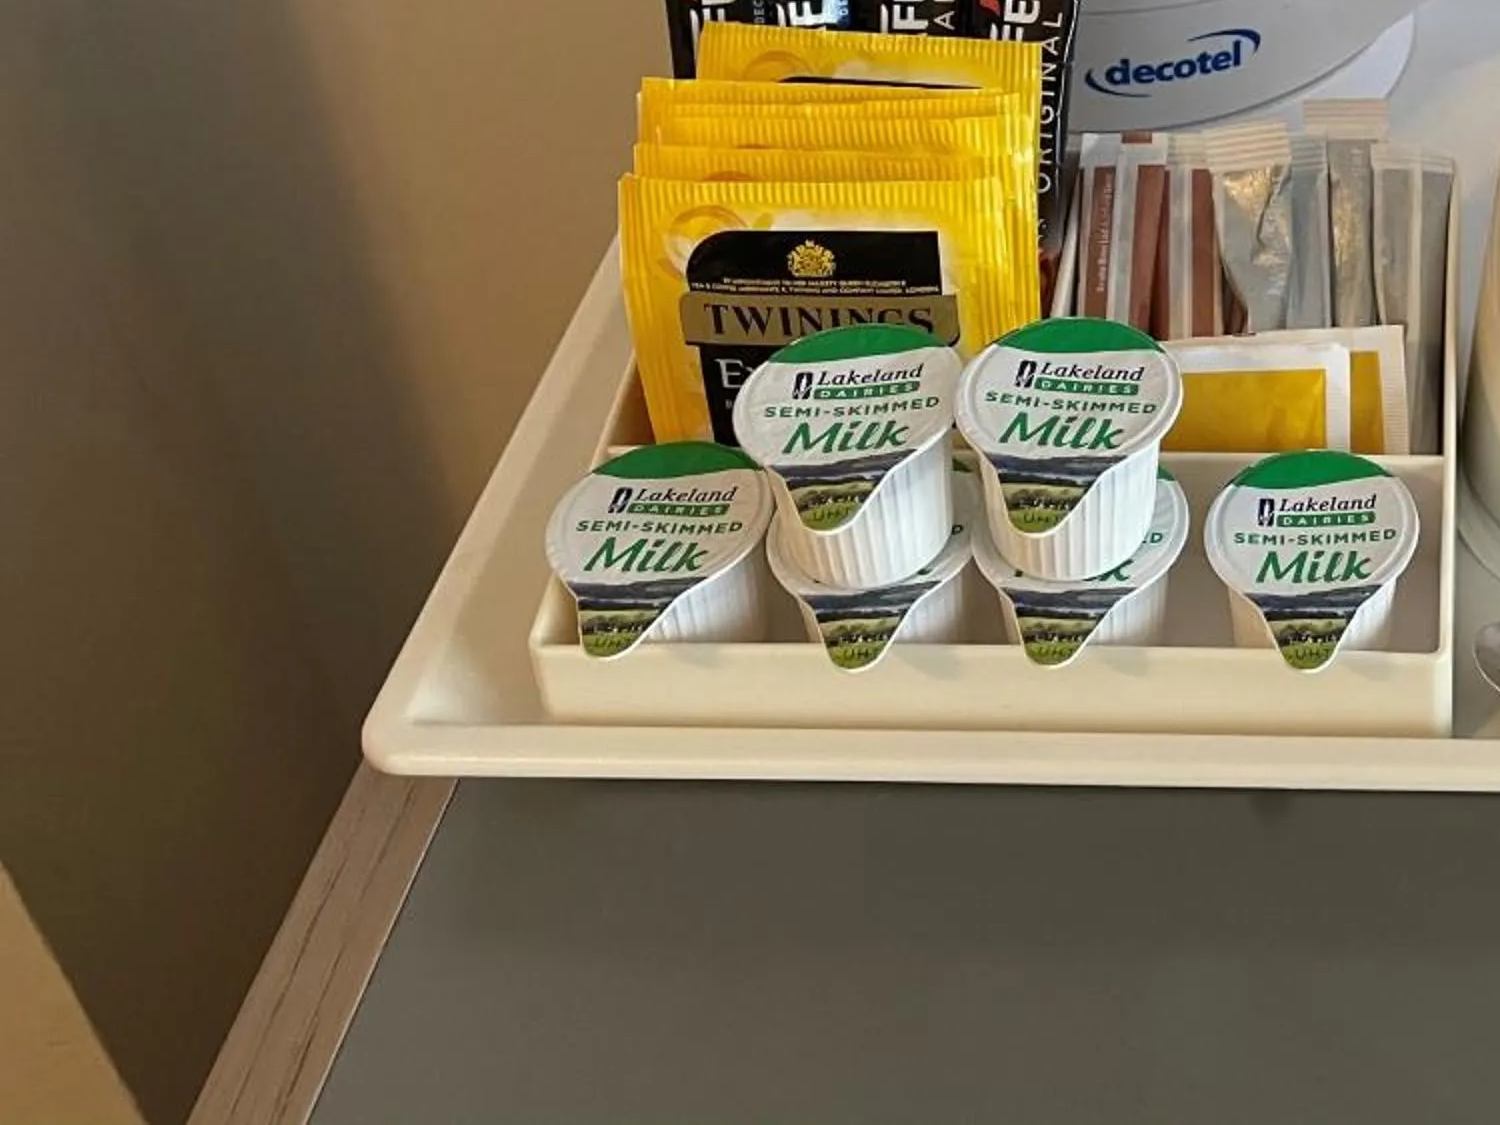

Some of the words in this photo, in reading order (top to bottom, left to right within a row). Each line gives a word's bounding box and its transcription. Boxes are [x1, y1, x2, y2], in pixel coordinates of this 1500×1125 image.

[1104, 39, 1242, 86] decotel
[703, 303, 934, 337] TWININGS
[816, 363, 924, 386] Lakeland
[1041, 361, 1145, 382] Lakeland
[819, 383, 914, 399] DAIRIES
[1041, 380, 1133, 395] DAIRIES
[763, 396, 940, 418] SEMI-SKIMMED
[984, 390, 1157, 415] SEMI-SKIMMED
[781, 420, 910, 455] Milk
[998, 410, 1125, 451] Milk
[635, 486, 739, 503] Lakeland
[1279, 493, 1377, 512] Lakeland
[632, 504, 723, 516] DAIRIES
[1282, 513, 1370, 526] DAIRIES
[575, 520, 743, 535] SEMI-SKIMMED
[1233, 528, 1397, 546] SEMI-SKIMMED
[583, 536, 709, 573] Milk
[1255, 549, 1372, 584] Milk
